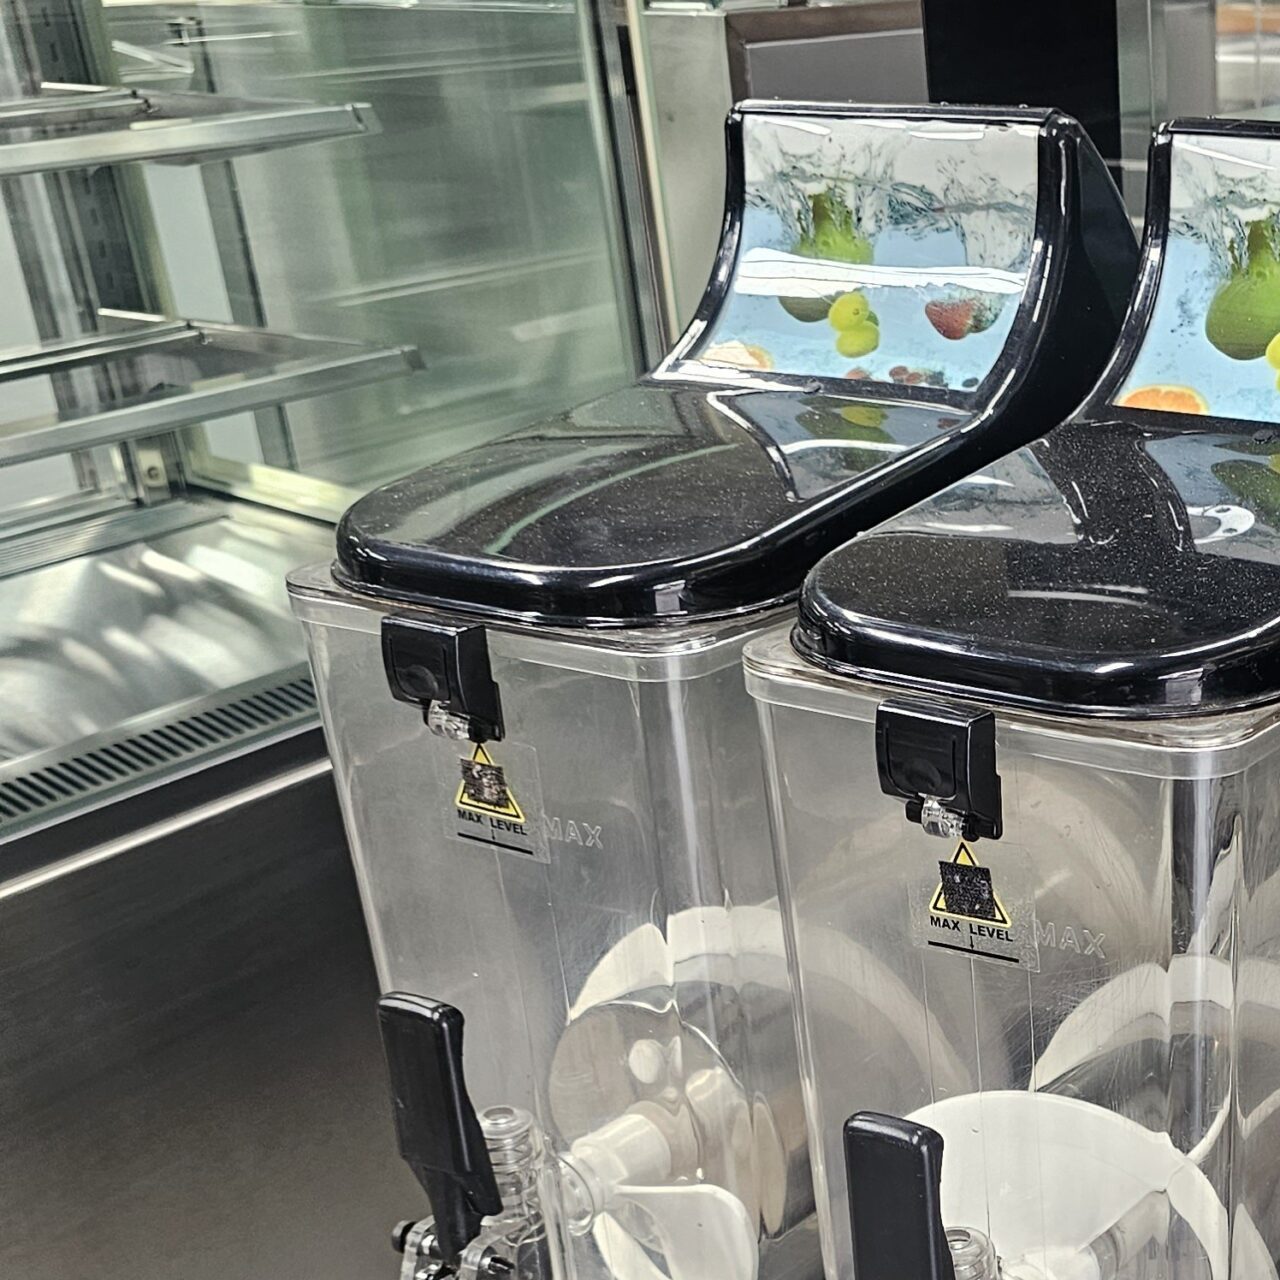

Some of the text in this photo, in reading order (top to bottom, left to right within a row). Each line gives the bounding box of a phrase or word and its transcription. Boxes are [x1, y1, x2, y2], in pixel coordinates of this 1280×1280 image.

[457, 809, 528, 836] MAX LEVEL
[545, 815, 604, 849] MAX
[929, 915, 1014, 942] MAX LEVEL
[1034, 919, 1106, 960] MAX
